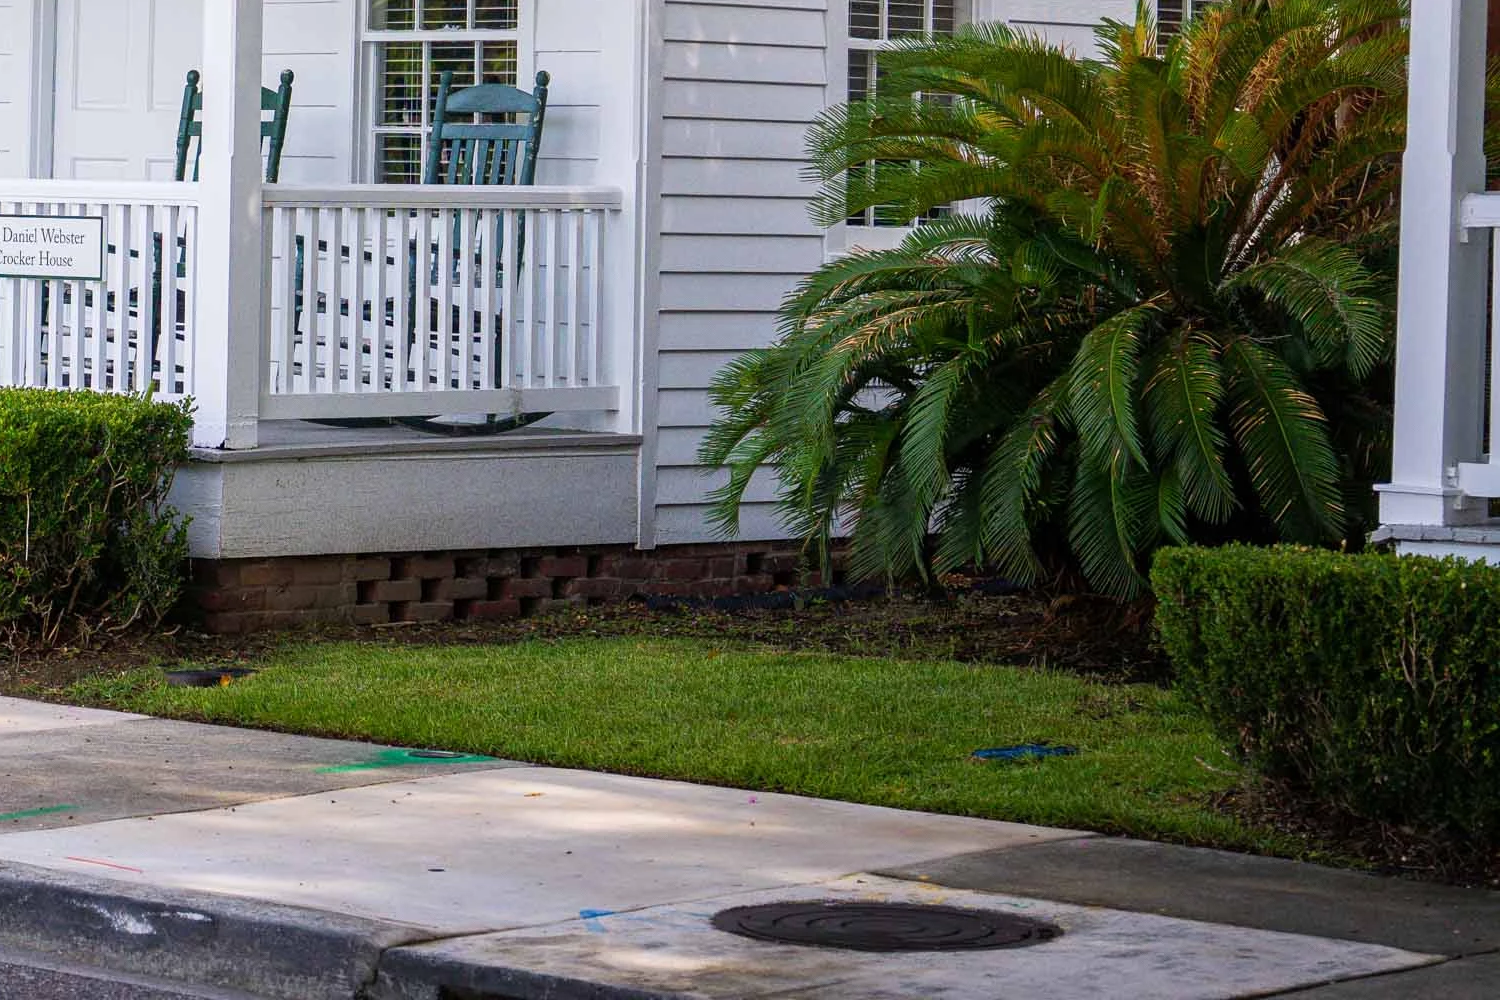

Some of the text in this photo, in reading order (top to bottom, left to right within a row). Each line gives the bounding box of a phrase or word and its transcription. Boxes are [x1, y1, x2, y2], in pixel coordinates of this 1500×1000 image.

[2, 227, 37, 243] Daniel
[41, 228, 85, 245] Webster
[38, 250, 73, 267] House
